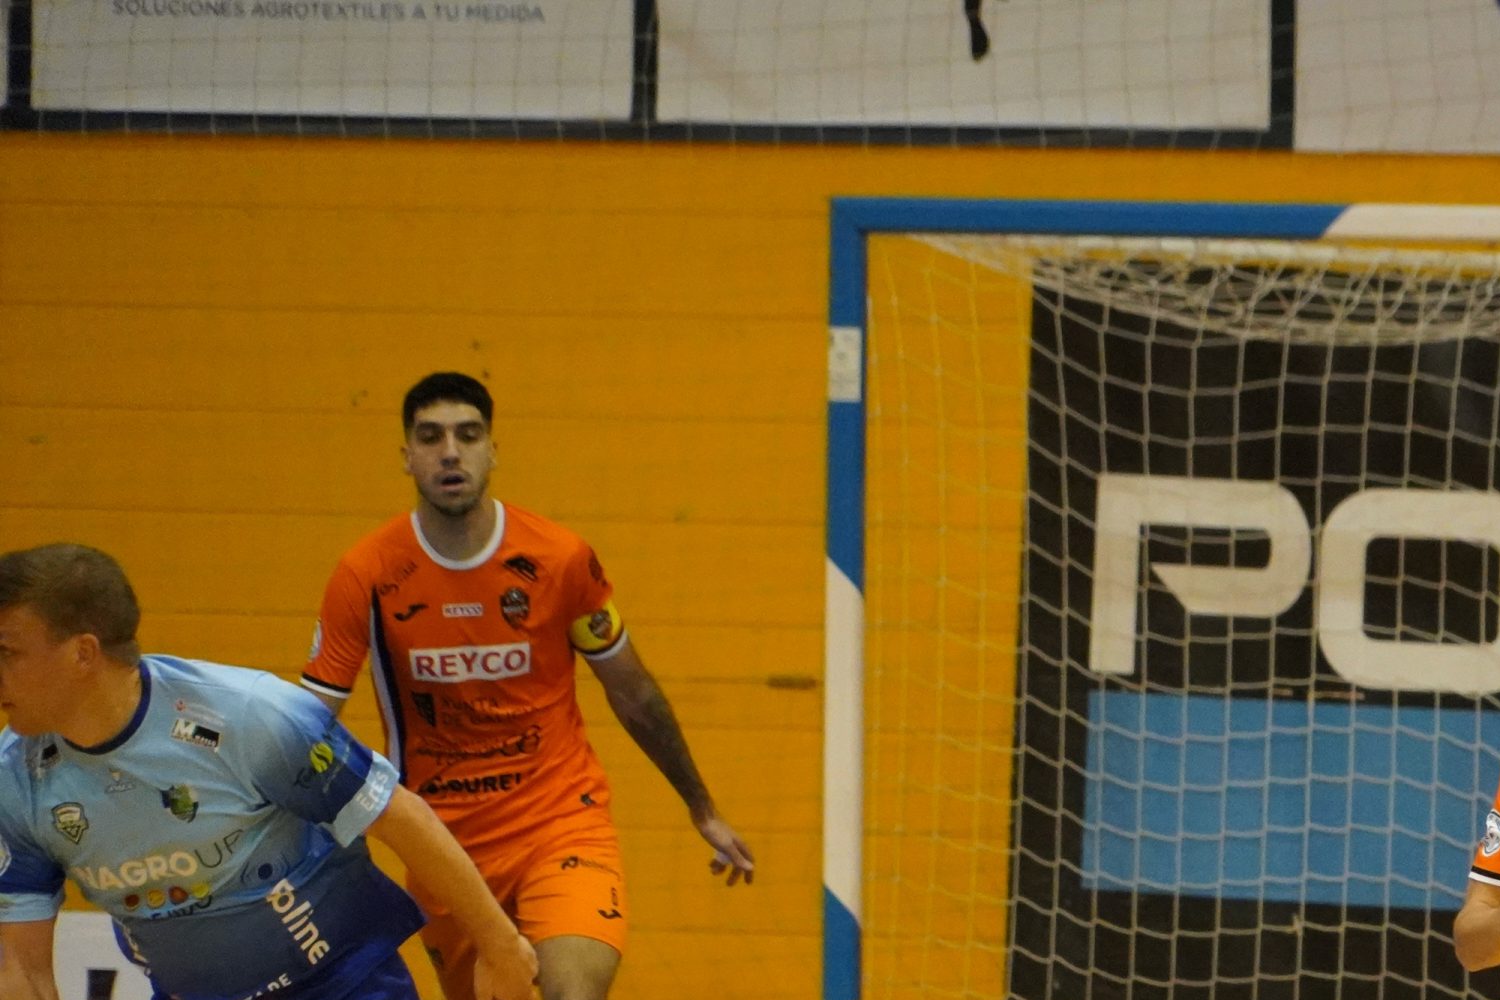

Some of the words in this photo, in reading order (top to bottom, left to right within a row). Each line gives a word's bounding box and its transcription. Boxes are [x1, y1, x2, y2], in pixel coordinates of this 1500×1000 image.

[112, 0, 244, 18] SOLUCIONES
[465, 7, 546, 24] MEDIDA
[414, 650, 527, 678] REYCO
